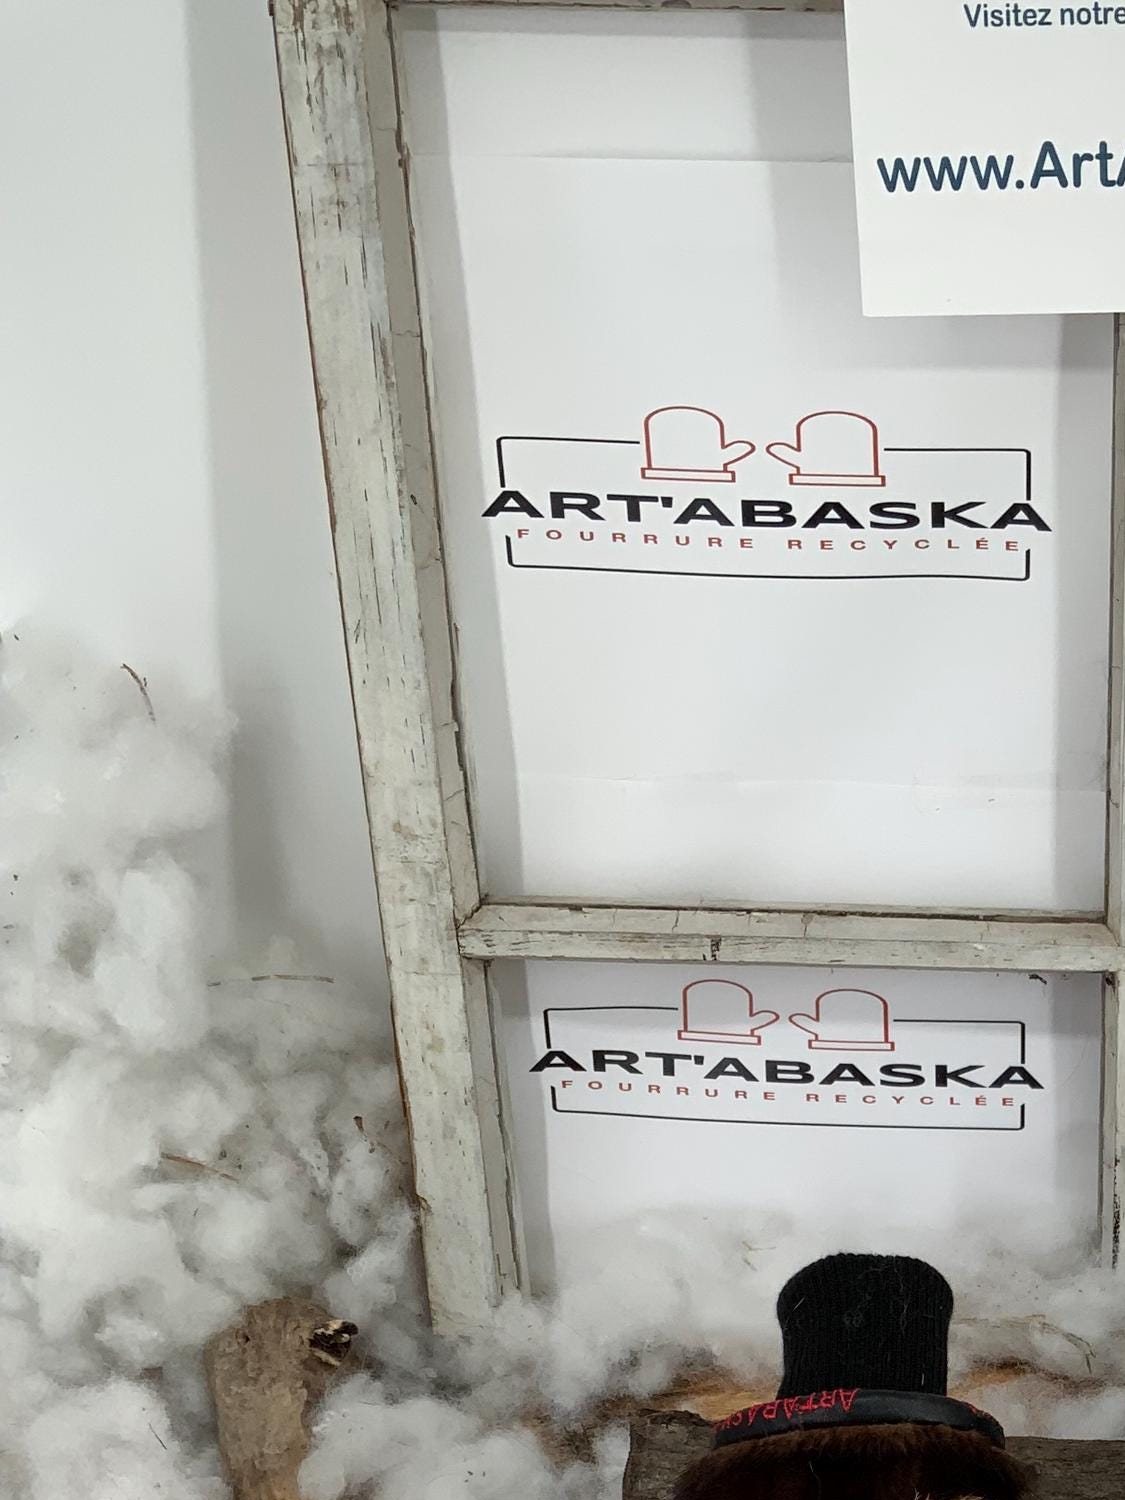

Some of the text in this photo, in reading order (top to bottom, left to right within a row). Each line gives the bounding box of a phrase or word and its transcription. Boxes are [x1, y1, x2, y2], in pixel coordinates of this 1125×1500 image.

[963, 1, 1052, 28] Visitez
[481, 490, 1052, 533] ART'ABASKA
[517, 529, 1020, 552] FOURRURE RECYCLÉE
[529, 1050, 1045, 1090] ART'ABASKA
[562, 1080, 1015, 1107] FOURRURE RECYCLÉE
